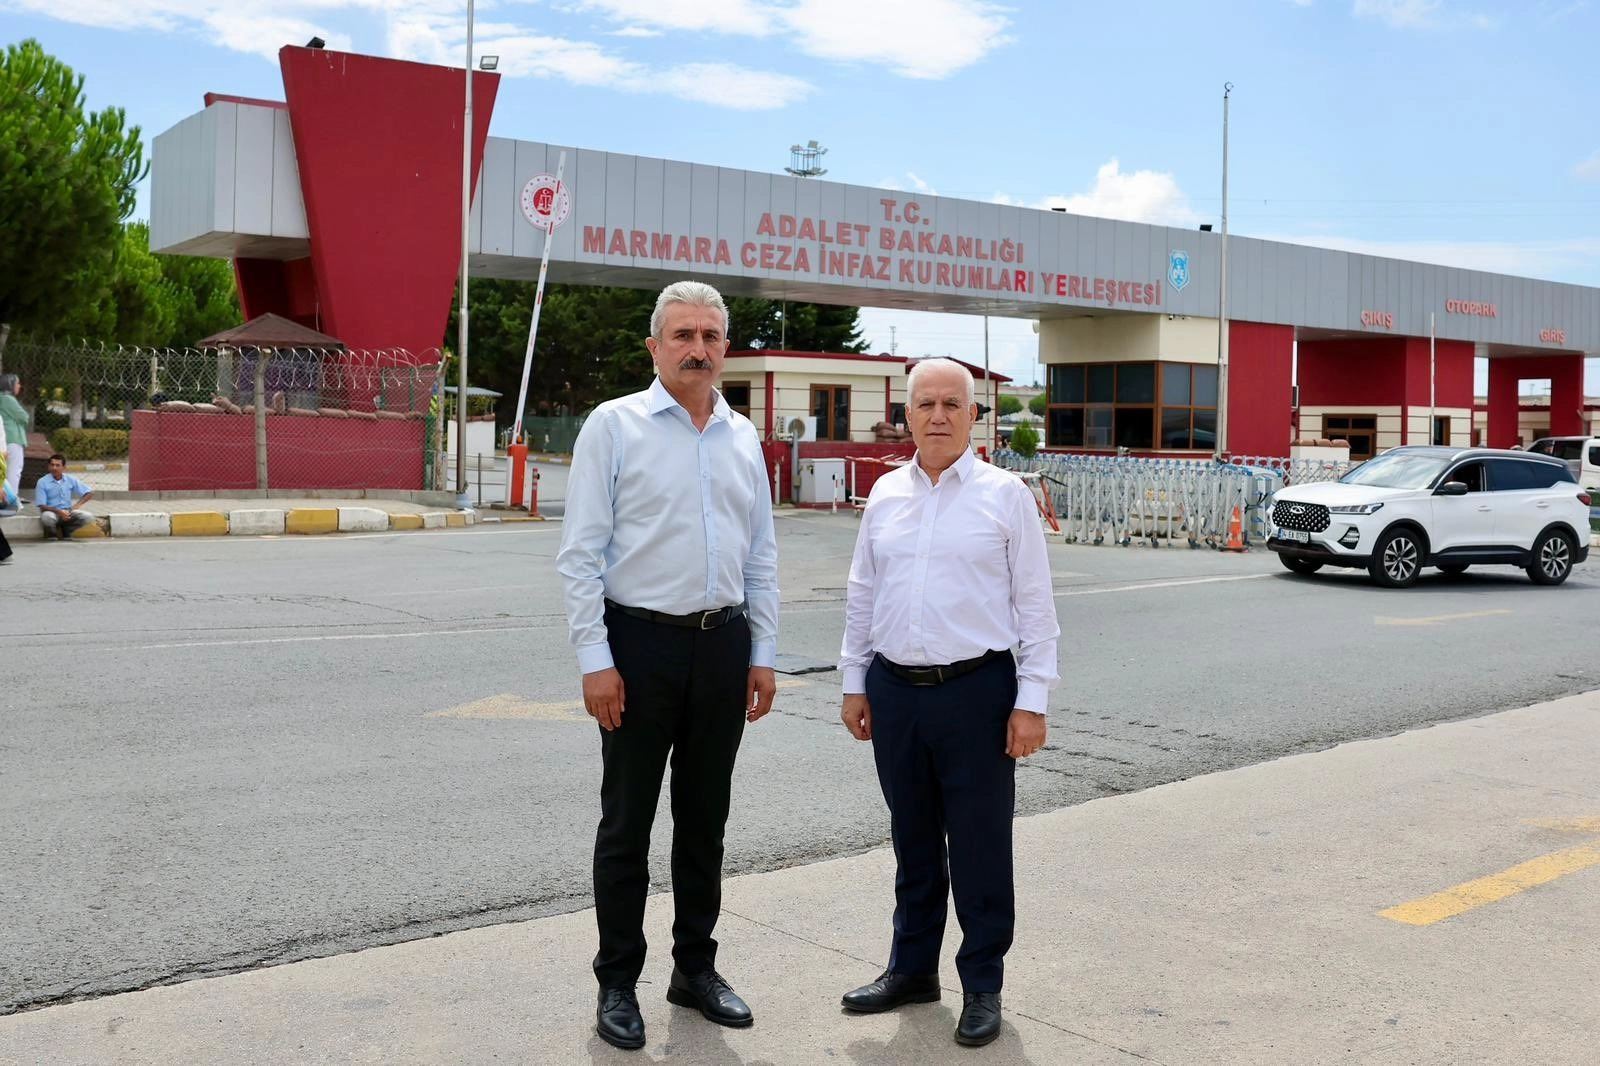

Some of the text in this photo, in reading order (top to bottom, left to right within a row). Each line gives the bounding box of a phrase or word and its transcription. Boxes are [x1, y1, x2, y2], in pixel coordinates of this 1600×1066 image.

[880, 198, 930, 225] T.C.
[756, 212, 1025, 264] ADALET BAKANLIĞI
[583, 225, 1162, 307] MARMARA CEZA İNFAZ KURUMLARI YERLEŞKESİ
[1445, 298, 1497, 319] OTOPARK
